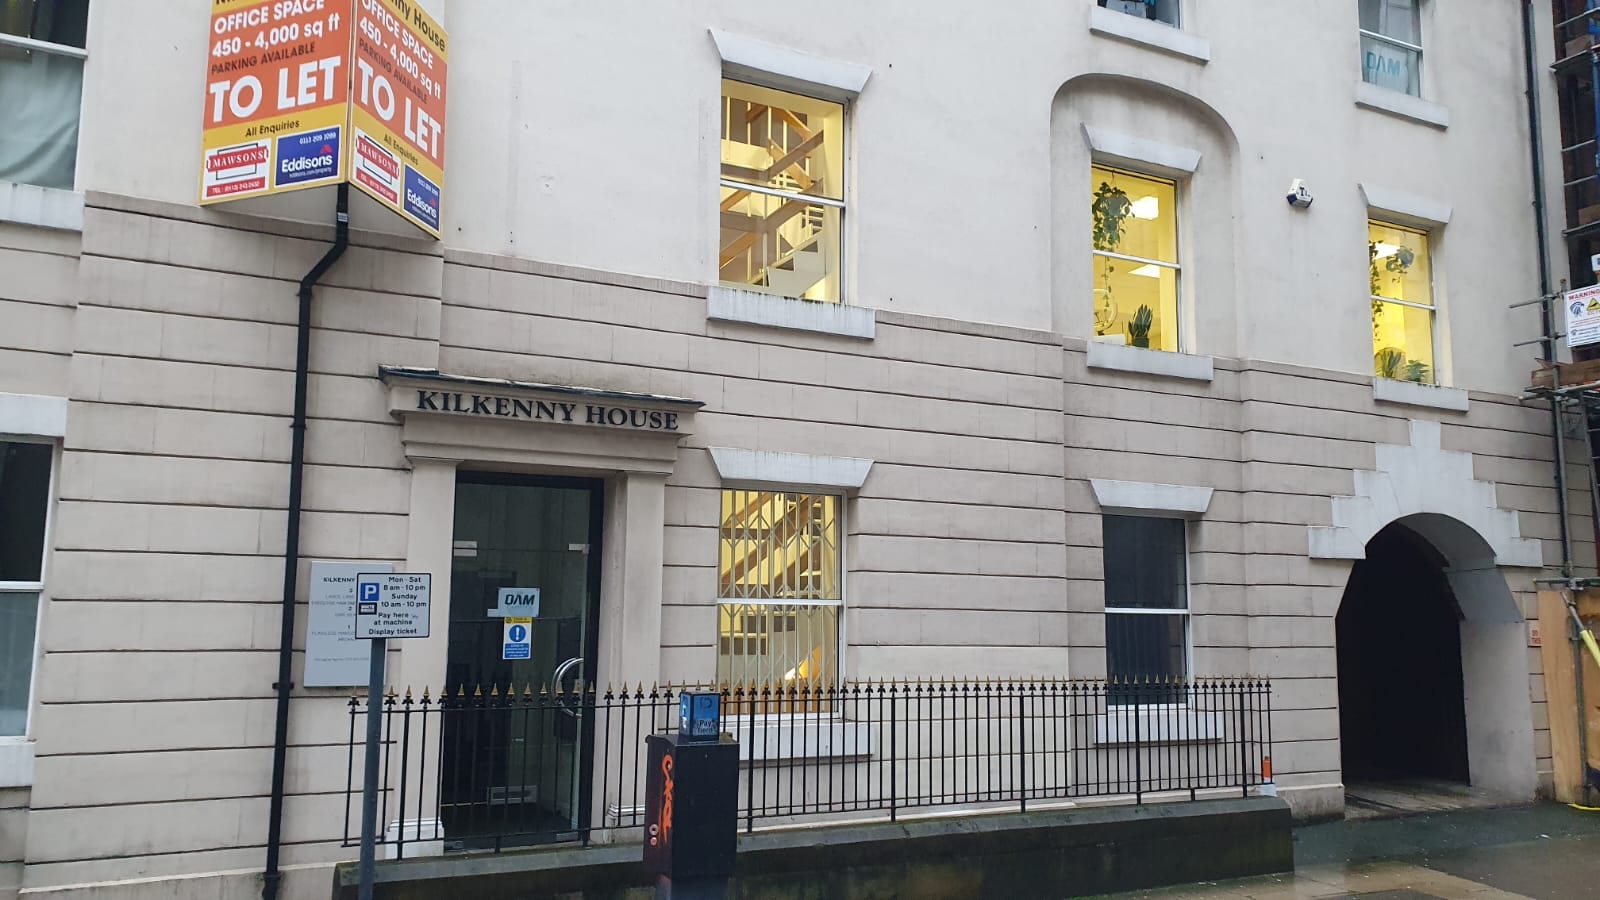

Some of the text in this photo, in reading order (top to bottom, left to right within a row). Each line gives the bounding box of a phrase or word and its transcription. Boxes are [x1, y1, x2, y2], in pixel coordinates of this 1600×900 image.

[214, 0, 324, 34] OFFICE SPACE
[414, 8, 446, 52] House
[212, 37, 241, 57] 450
[254, 23, 299, 50] 4,000
[304, 20, 323, 38] sq
[328, 12, 340, 32] ft
[362, 0, 400, 39] OFFICE
[401, 28, 433, 70] SPACE
[211, 42, 315, 75] PARKING AVAILABLE
[359, 38, 427, 104] PARKING AVAILABLE
[360, 16, 381, 46] 450
[390, 43, 419, 79] 4,000
[419, 72, 432, 96] sq
[434, 81, 441, 100] ft
[210, 55, 341, 123] TO LET
[358, 56, 441, 160] TO LET
[245, 120, 300, 138] All Enquiries
[212, 151, 264, 168] MAWSONS
[281, 155, 333, 173] Eddisons
[361, 143, 397, 175] MAWSONS
[384, 133, 419, 166] All Enquiries
[407, 188, 437, 218] Eddisons
[417, 390, 679, 431] KILKENNY HOUSE
[364, 584, 377, 600] P
[504, 594, 535, 606] DAM
